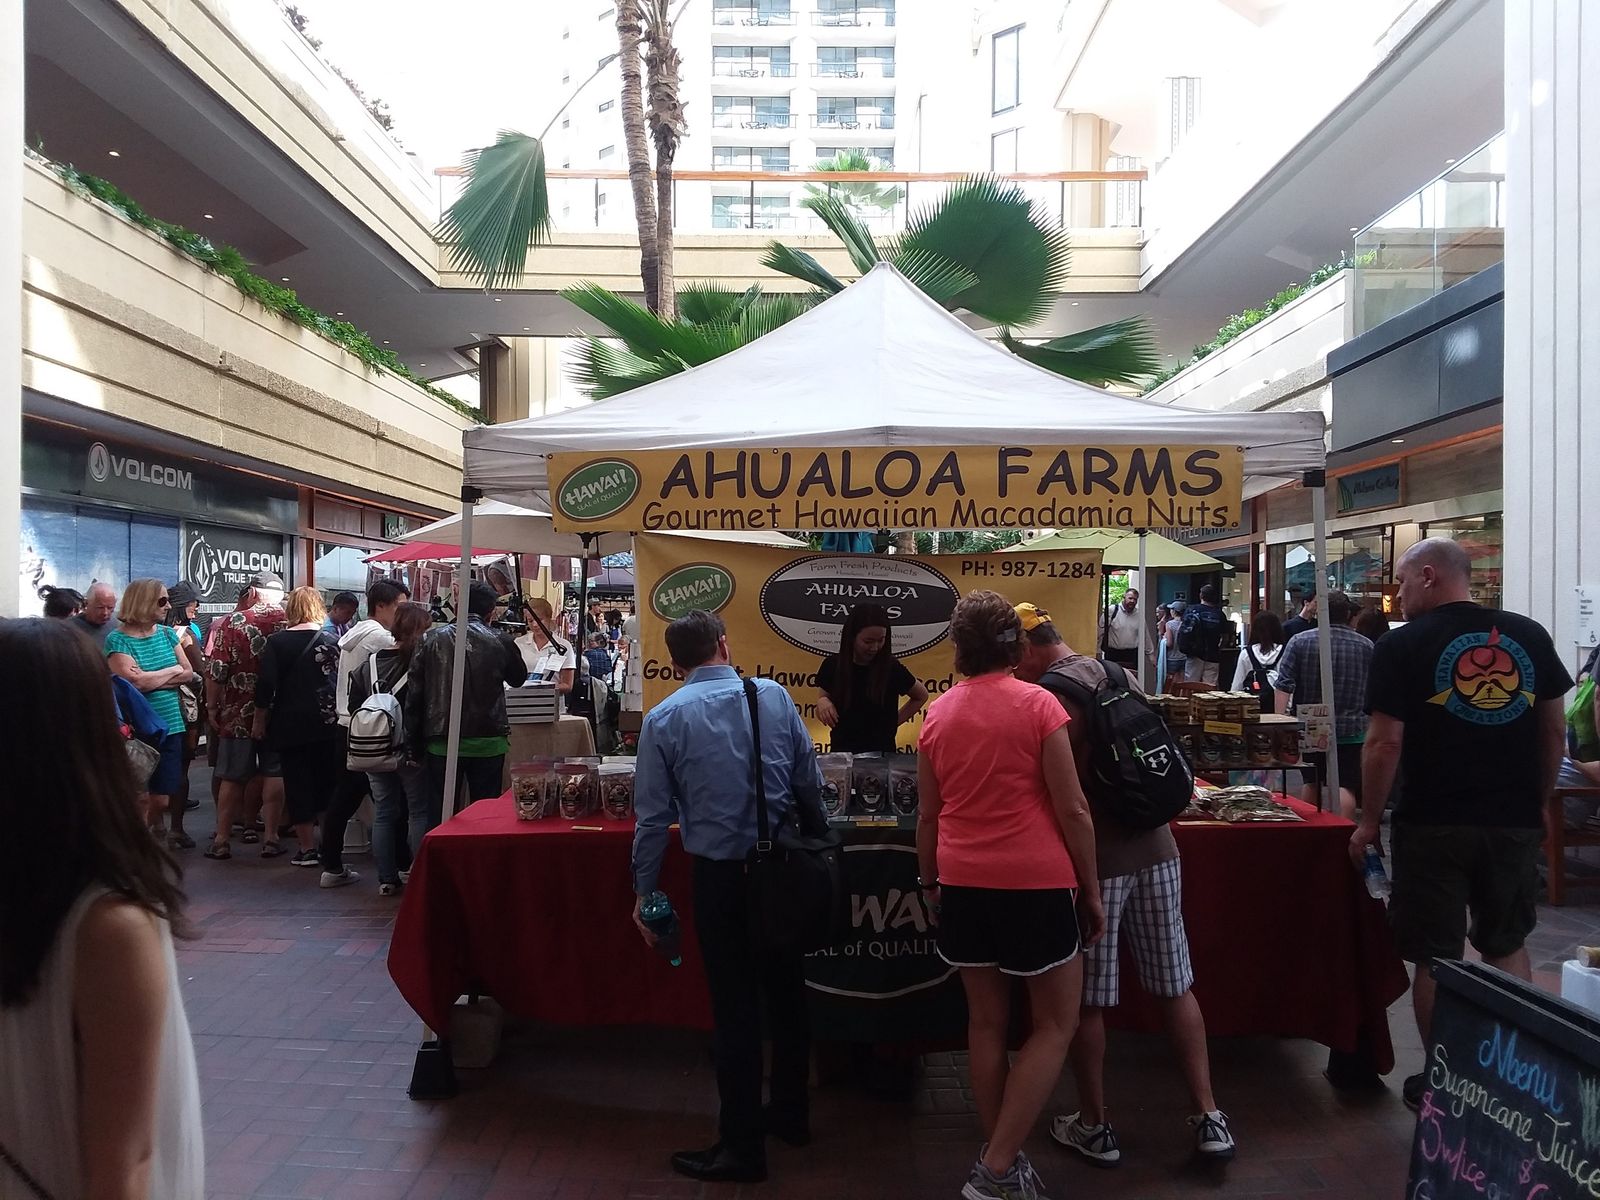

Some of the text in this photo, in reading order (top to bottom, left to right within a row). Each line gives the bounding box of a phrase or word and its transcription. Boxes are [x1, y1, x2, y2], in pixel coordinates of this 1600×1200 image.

[110, 454, 192, 490] VOLCOM
[659, 447, 1223, 499] AHUALOA FARMS
[642, 501, 781, 530] Gourmet
[795, 499, 937, 528] Hawaiian
[950, 497, 1133, 528] Macadamia
[217, 549, 283, 573] VOLCOM
[809, 562, 837, 572] Farm
[840, 561, 868, 570] Fresh
[872, 561, 918, 577] Products
[961, 560, 1096, 579] PH: 987-1284
[223, 572, 246, 583] TRUE
[804, 582, 919, 599] AHUALOA
[819, 602, 902, 619] FAS
[1438, 634, 1535, 688] HAWAIIAN ISLAND
[844, 940, 863, 956] of
[868, 938, 937, 960] QUALIT
[1478, 1022, 1564, 1114] Menu
[1430, 1043, 1600, 1198] Sugarcane Juice
